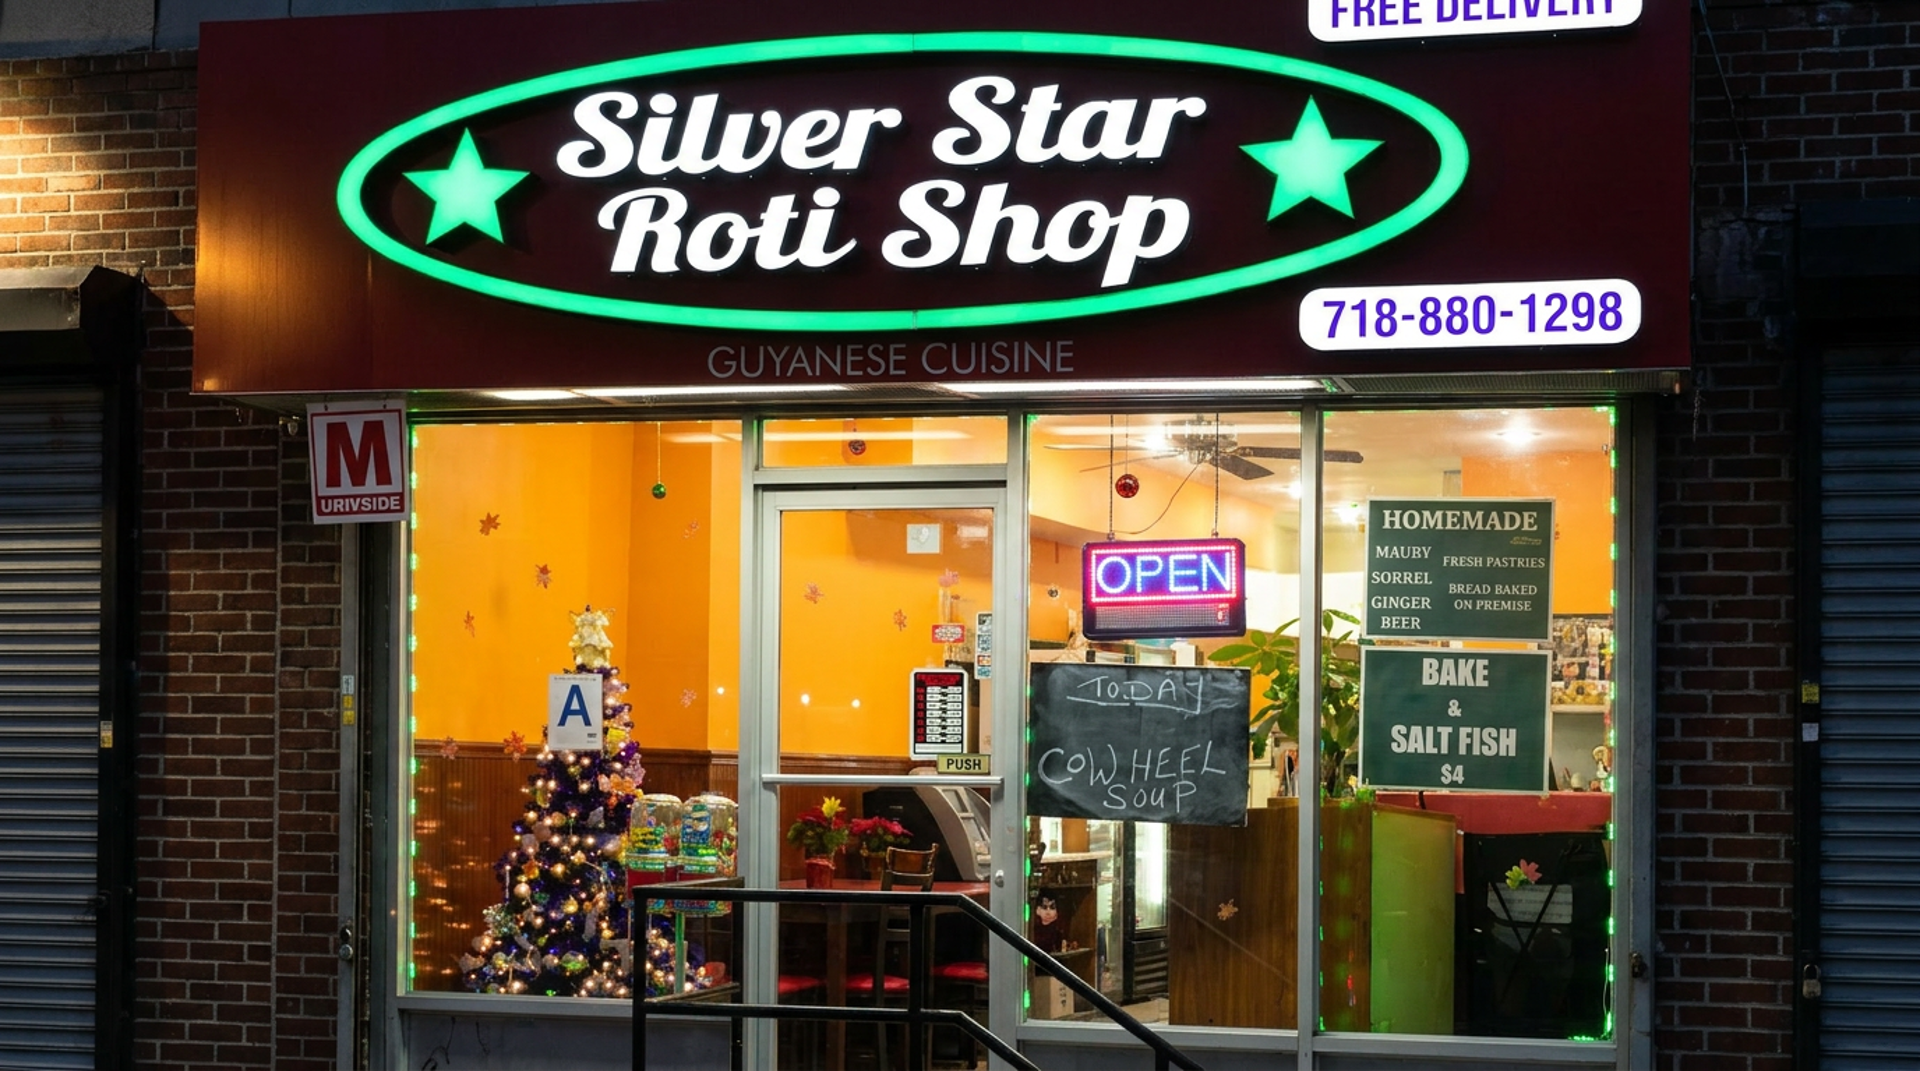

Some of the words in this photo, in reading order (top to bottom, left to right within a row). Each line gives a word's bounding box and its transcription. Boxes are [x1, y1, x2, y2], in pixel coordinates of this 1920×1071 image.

[1331, 0, 1422, 28] FREE
[556, 91, 902, 178] Silver
[932, 75, 1207, 165] Star
[598, 186, 857, 273] Roti
[881, 179, 1190, 288] Shop
[1323, 291, 1623, 339] 718-880-1298
[707, 344, 907, 379] GUYANESE
[921, 341, 1074, 375] CUISINE
[326, 420, 392, 488] M
[320, 496, 401, 512] URIVSIDE
[1382, 509, 1538, 531] HOMEMADE
[1375, 545, 1432, 559] MAUBY
[1442, 556, 1483, 568] FRESH
[1486, 557, 1546, 569] PASTRIES
[1096, 553, 1232, 595] OPEN
[1371, 571, 1433, 585] SORREL
[1371, 596, 1432, 610] GINGER
[1448, 583, 1491, 595] BREAD
[1494, 584, 1538, 596] BAKED
[1454, 599, 1473, 611] ON
[1476, 600, 1533, 612] PREMISE
[1381, 616, 1422, 630] BEER
[1422, 657, 1489, 687] BAKE
[557, 684, 592, 727] A
[1077, 675, 1203, 715] TODAY
[1447, 699, 1462, 717] &
[1390, 724, 1453, 754] SALT
[1458, 727, 1517, 757] FISH
[946, 758, 982, 770] PUSH
[1038, 744, 1117, 787] COW
[1131, 740, 1226, 784] HEEL
[1440, 763, 1465, 785] $4
[1103, 780, 1197, 813] SOUP
